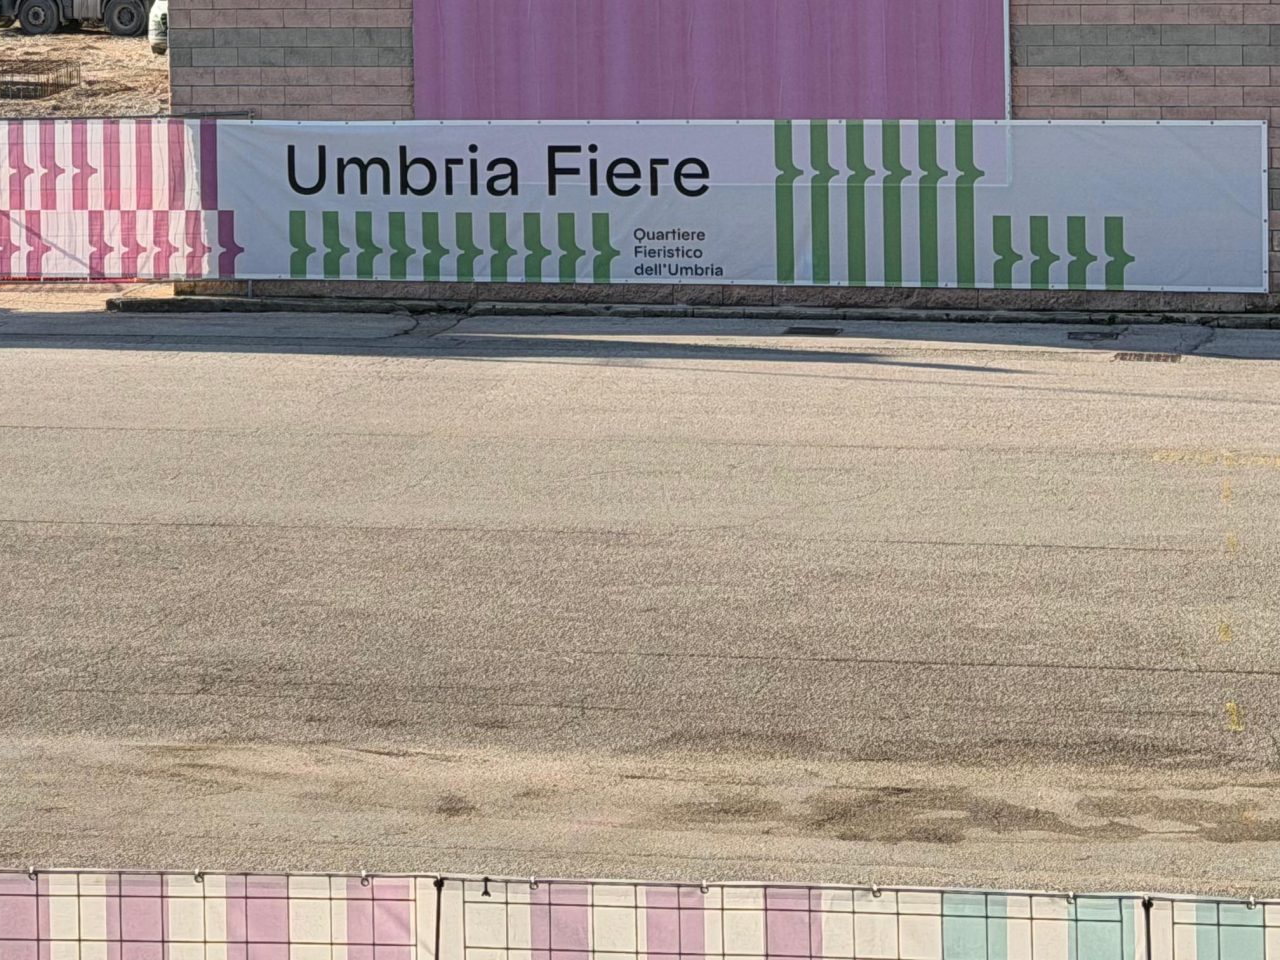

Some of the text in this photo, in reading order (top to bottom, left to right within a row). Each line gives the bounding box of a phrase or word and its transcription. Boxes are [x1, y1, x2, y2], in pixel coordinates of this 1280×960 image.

[287, 144, 710, 197] Umbria Fiere
[634, 227, 706, 244] Quartiere
[634, 245, 703, 259] Fieristico
[634, 263, 724, 277] dell'Umbria
